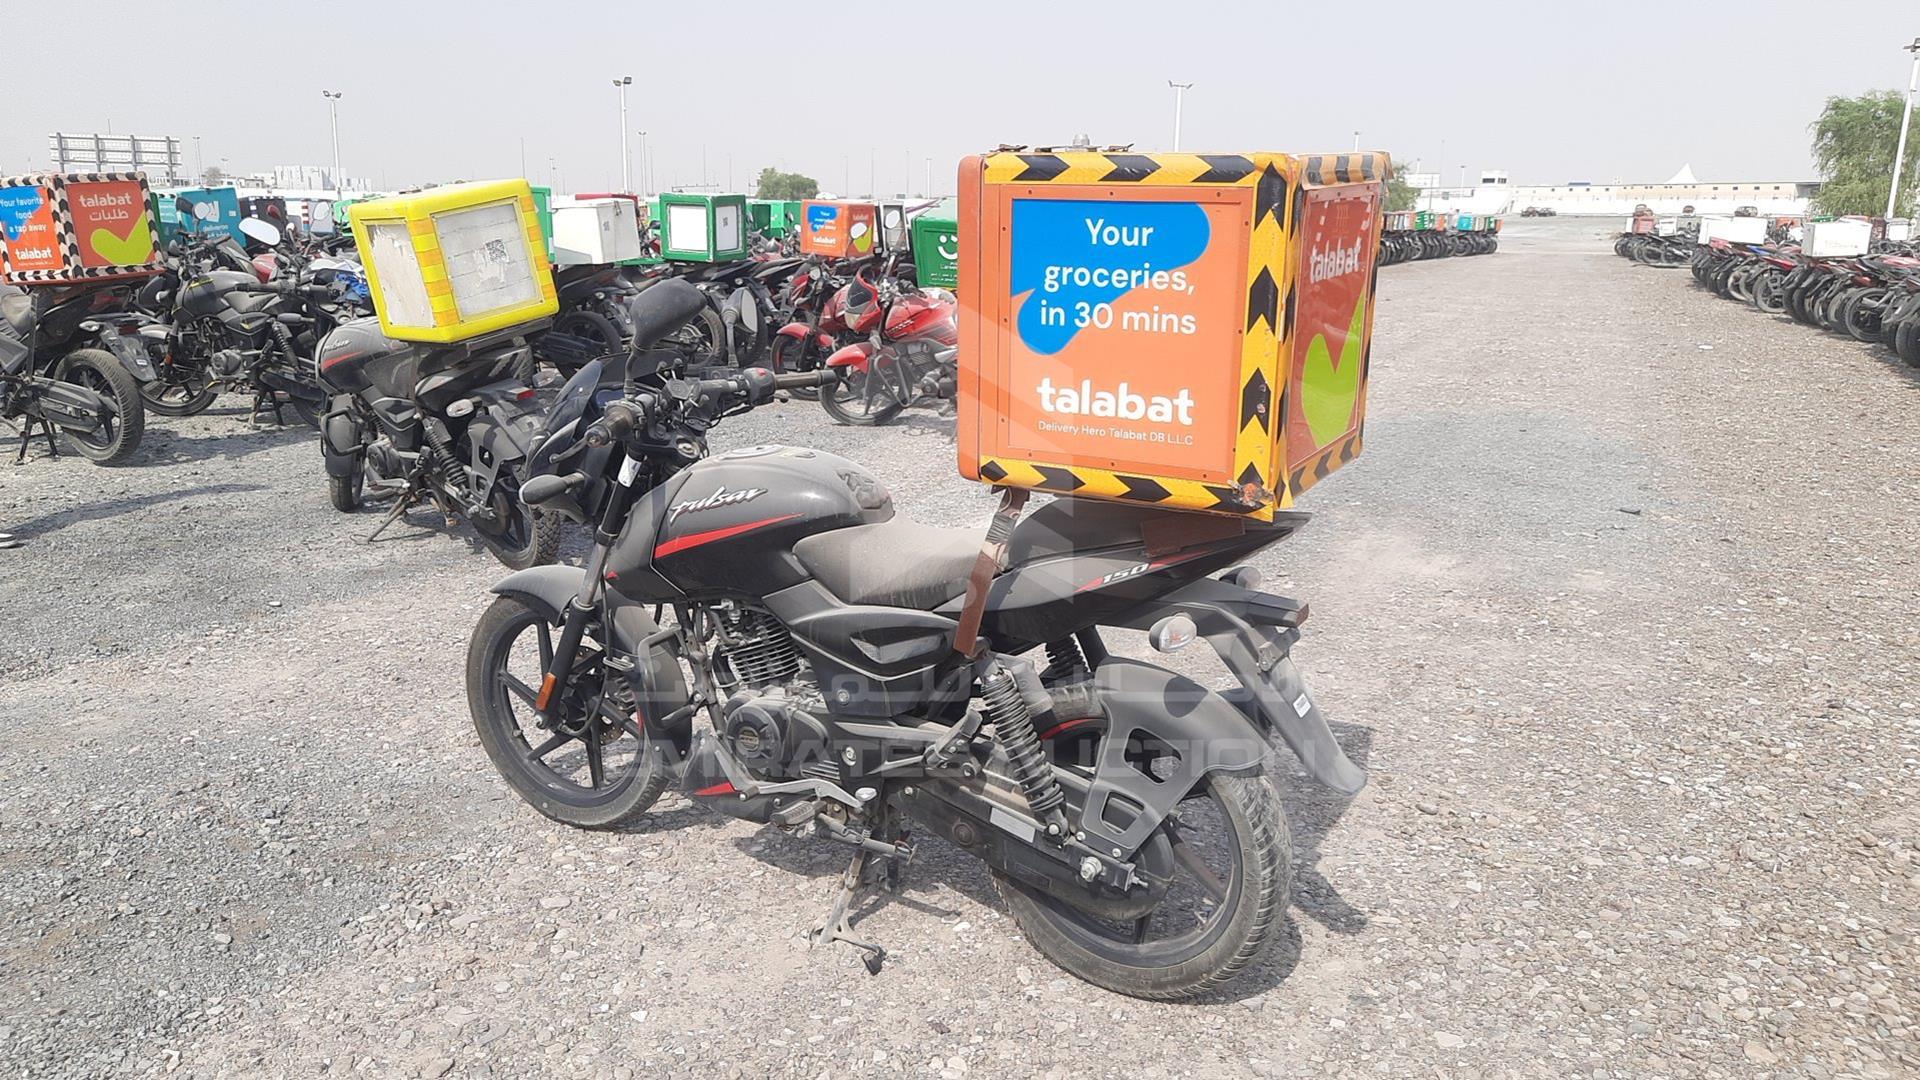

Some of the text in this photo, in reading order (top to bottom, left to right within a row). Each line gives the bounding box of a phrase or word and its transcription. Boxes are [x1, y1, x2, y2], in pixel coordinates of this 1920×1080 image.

[16, 197, 43, 207] favorite
[79, 192, 132, 208] talabat
[89, 208, 129, 223] طلبات
[15, 225, 27, 234] tap
[28, 224, 47, 232] away
[1085, 218, 1154, 247] Your
[15, 247, 52, 260] talabat
[1310, 236, 1361, 284] talabat
[1044, 263, 1195, 296] groceries,
[1040, 300, 1196, 335] in 30 mins
[1036, 377, 1195, 426] talabat
[1038, 420, 1079, 436] Delivery
[1081, 425, 1106, 436] Hero
[1108, 427, 1147, 441] Talabat
[1150, 431, 1165, 442] DB
[1104, 563, 1149, 584] 150
